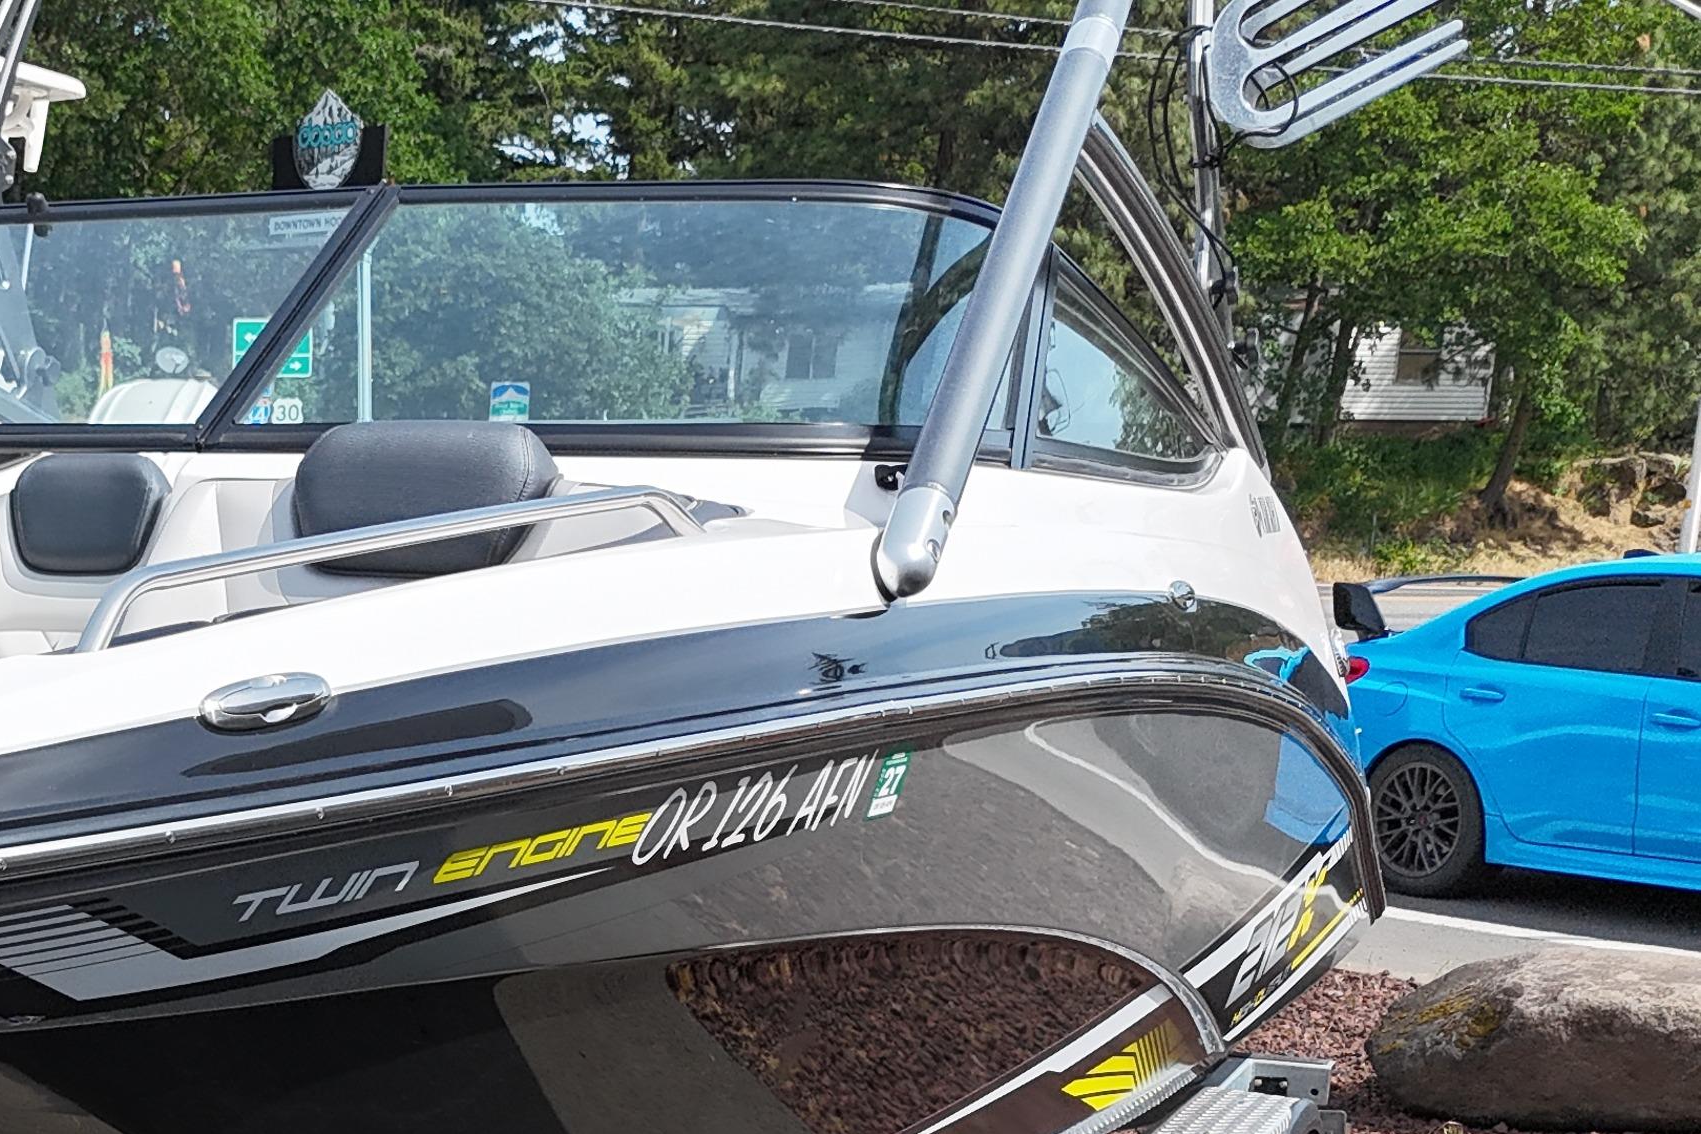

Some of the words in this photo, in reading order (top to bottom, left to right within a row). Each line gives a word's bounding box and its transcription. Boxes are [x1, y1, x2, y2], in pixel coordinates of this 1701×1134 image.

[274, 217, 322, 231] DOWNTOWN
[276, 404, 299, 422] 30
[878, 764, 907, 798] 27
[631, 780, 718, 867] OR
[702, 763, 798, 852] 126
[786, 748, 879, 837] AFN
[232, 861, 420, 923] TWIN
[432, 810, 652, 885] ENGINE
